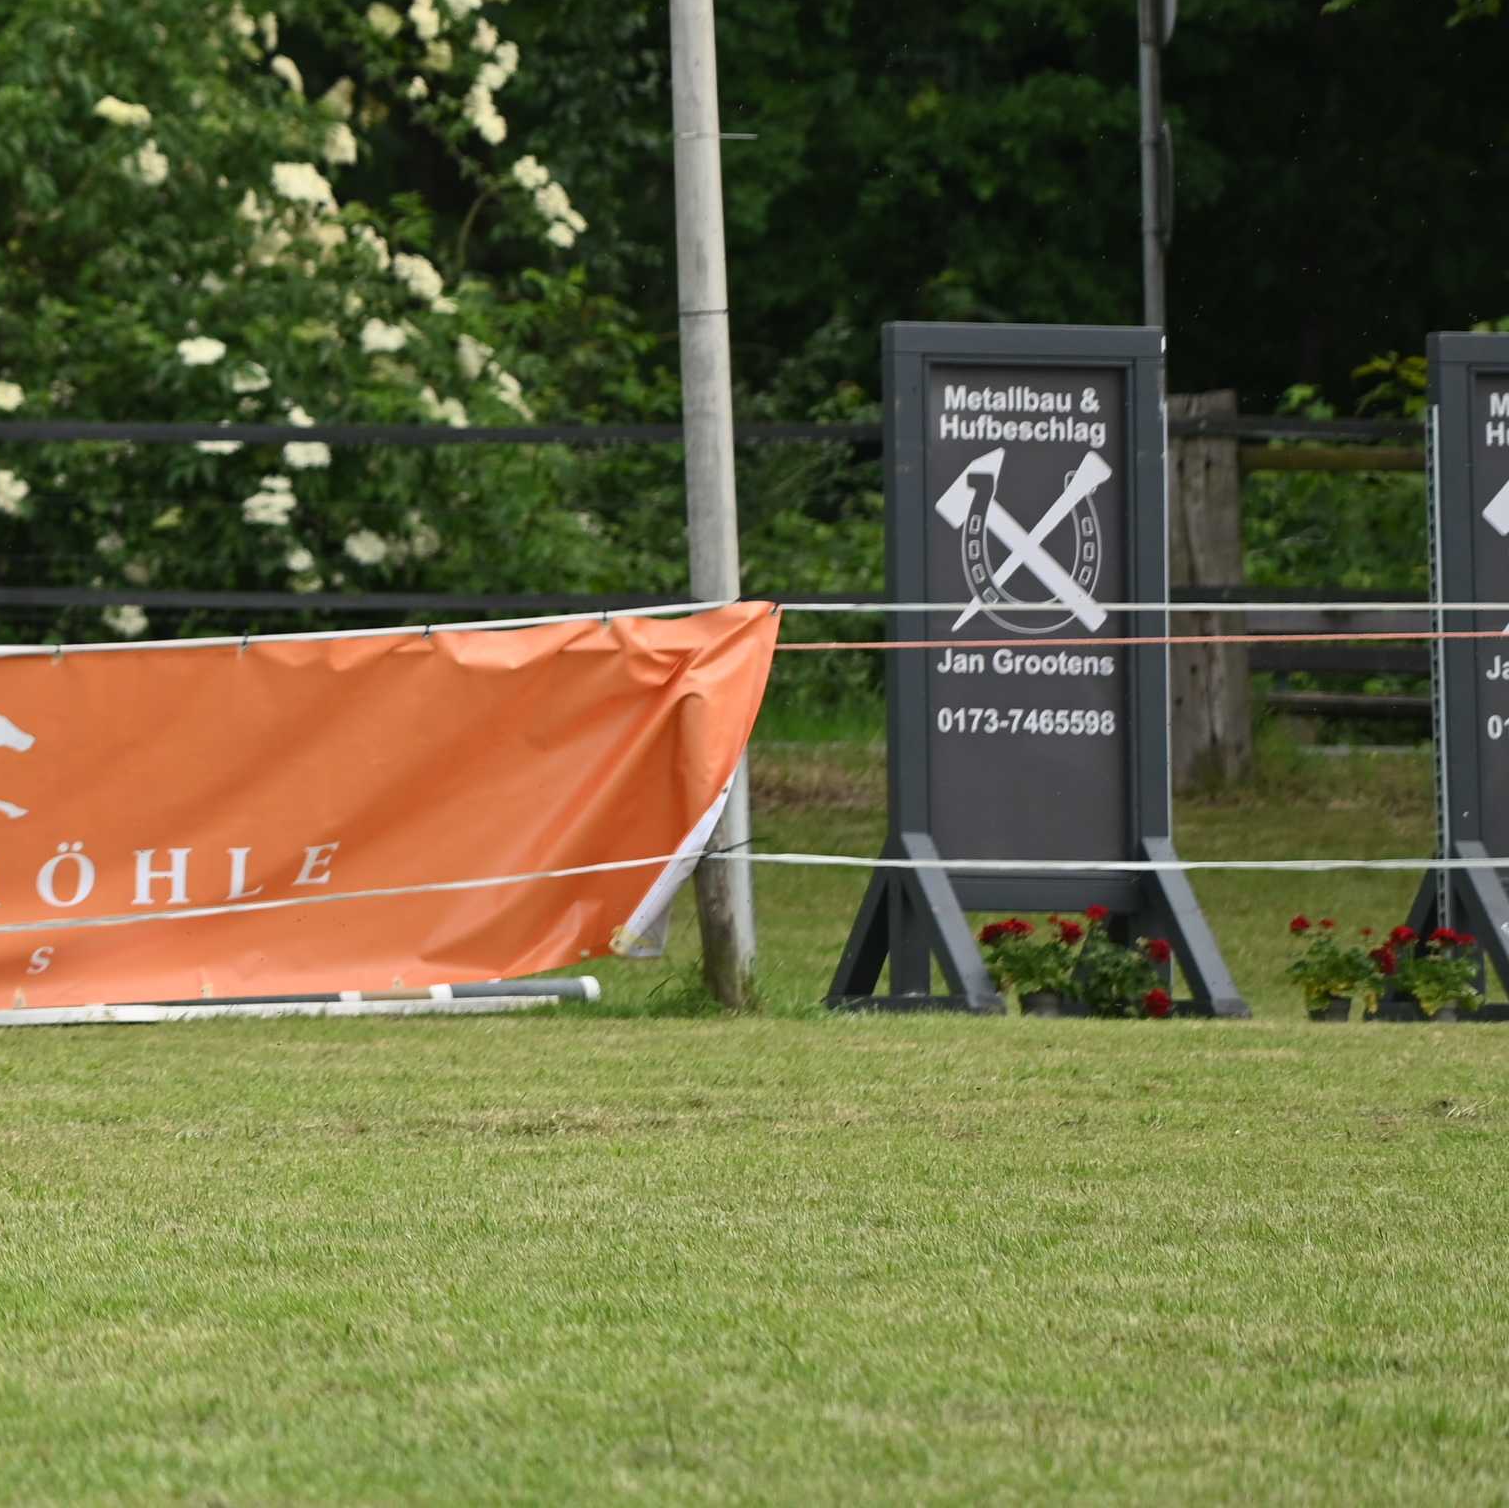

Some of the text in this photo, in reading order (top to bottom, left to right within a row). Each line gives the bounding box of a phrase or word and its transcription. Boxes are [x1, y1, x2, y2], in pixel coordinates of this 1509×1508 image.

[944, 385, 1100, 413] Metallbau &
[940, 414, 1106, 448] Hufbeschlag
[937, 648, 1115, 676] Jan Grootens
[937, 707, 1116, 735] 0173-7465598
